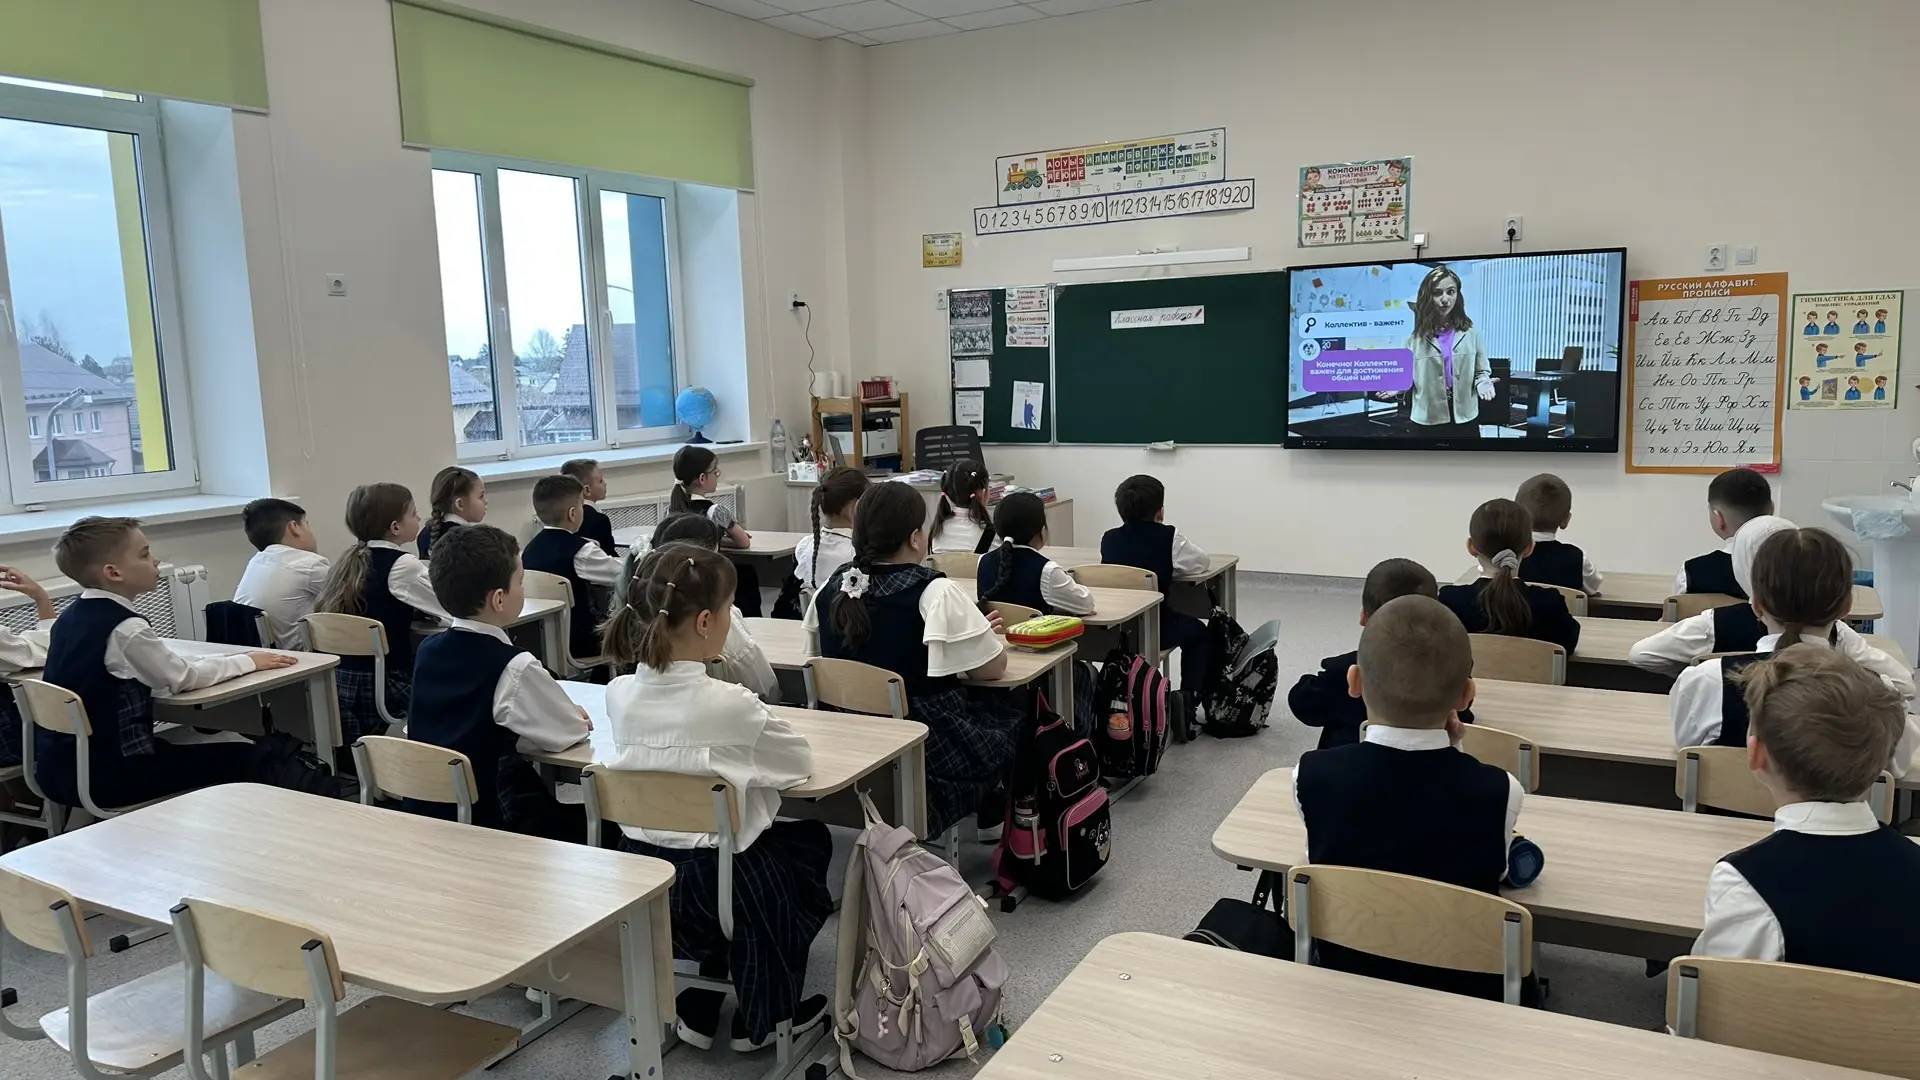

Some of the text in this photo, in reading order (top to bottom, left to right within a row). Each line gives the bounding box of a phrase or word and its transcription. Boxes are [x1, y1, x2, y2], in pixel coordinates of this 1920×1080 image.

[1327, 165, 1380, 175] КОМПОНЕНТЫ
[1328, 171, 1378, 179] МАТЕМАТИЧЕСКИХ
[979, 185, 1250, 229] 0 1 2 3 4 5 6 7 8 9 10 11 12 13 14 15 16 17 18 19 20
[1657, 278, 1757, 291] РУССКИЙ АЛФАВИТ.
[1682, 288, 1730, 298] ПРОПИСИ
[1114, 308, 1193, 324] Классная работа
[1324, 321, 1367, 329] Коллектив
[1352, 366, 1404, 374] достижения
[1331, 373, 1359, 382] общей
